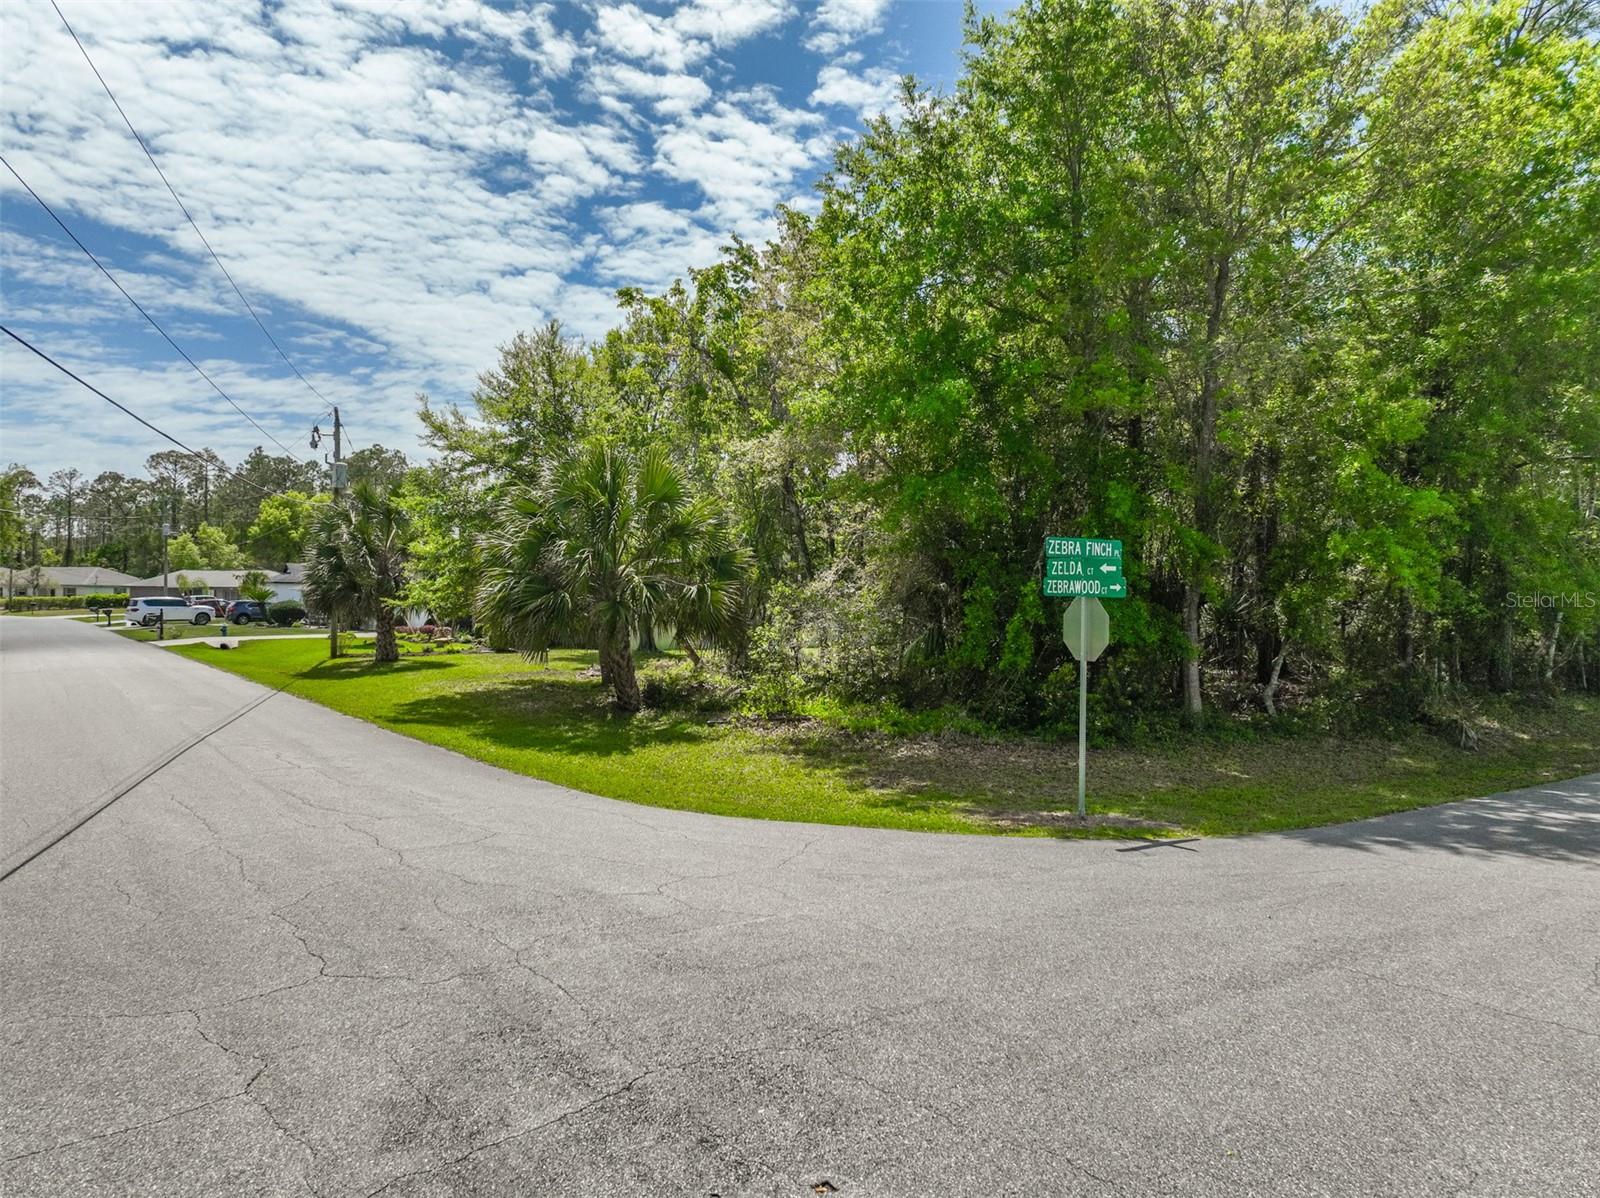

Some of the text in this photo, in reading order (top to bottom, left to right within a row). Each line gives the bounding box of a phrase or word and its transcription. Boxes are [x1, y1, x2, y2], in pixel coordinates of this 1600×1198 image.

[1048, 540, 1081, 555] ZEBRA
[1086, 541, 1112, 556] FINCH
[1051, 561, 1094, 575] ZELDA CT
[1047, 580, 1108, 594] ZEBRAWOOD CT
